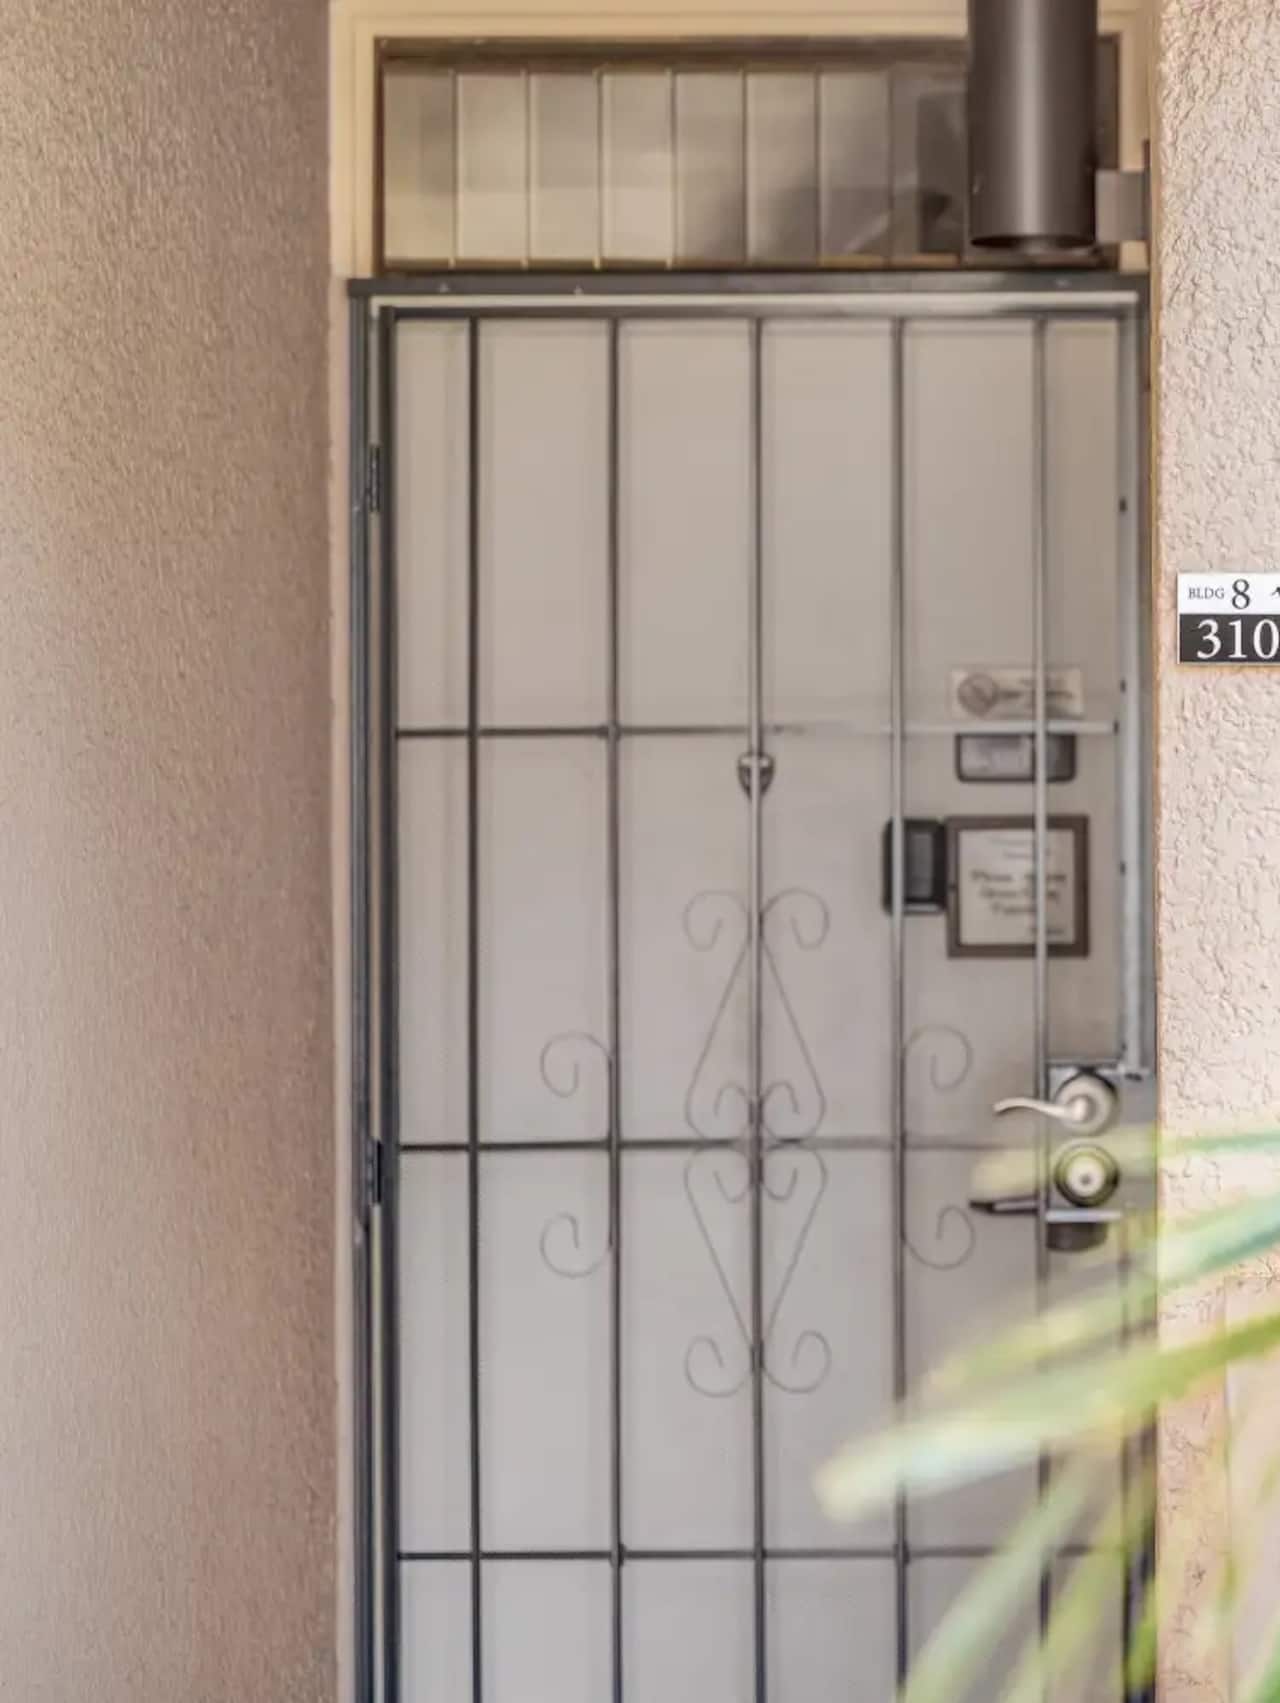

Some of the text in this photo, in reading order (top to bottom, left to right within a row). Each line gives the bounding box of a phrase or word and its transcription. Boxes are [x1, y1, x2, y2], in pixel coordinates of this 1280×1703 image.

[1188, 578, 1250, 610] BLDG 8
[1197, 618, 1280, 659] 310
